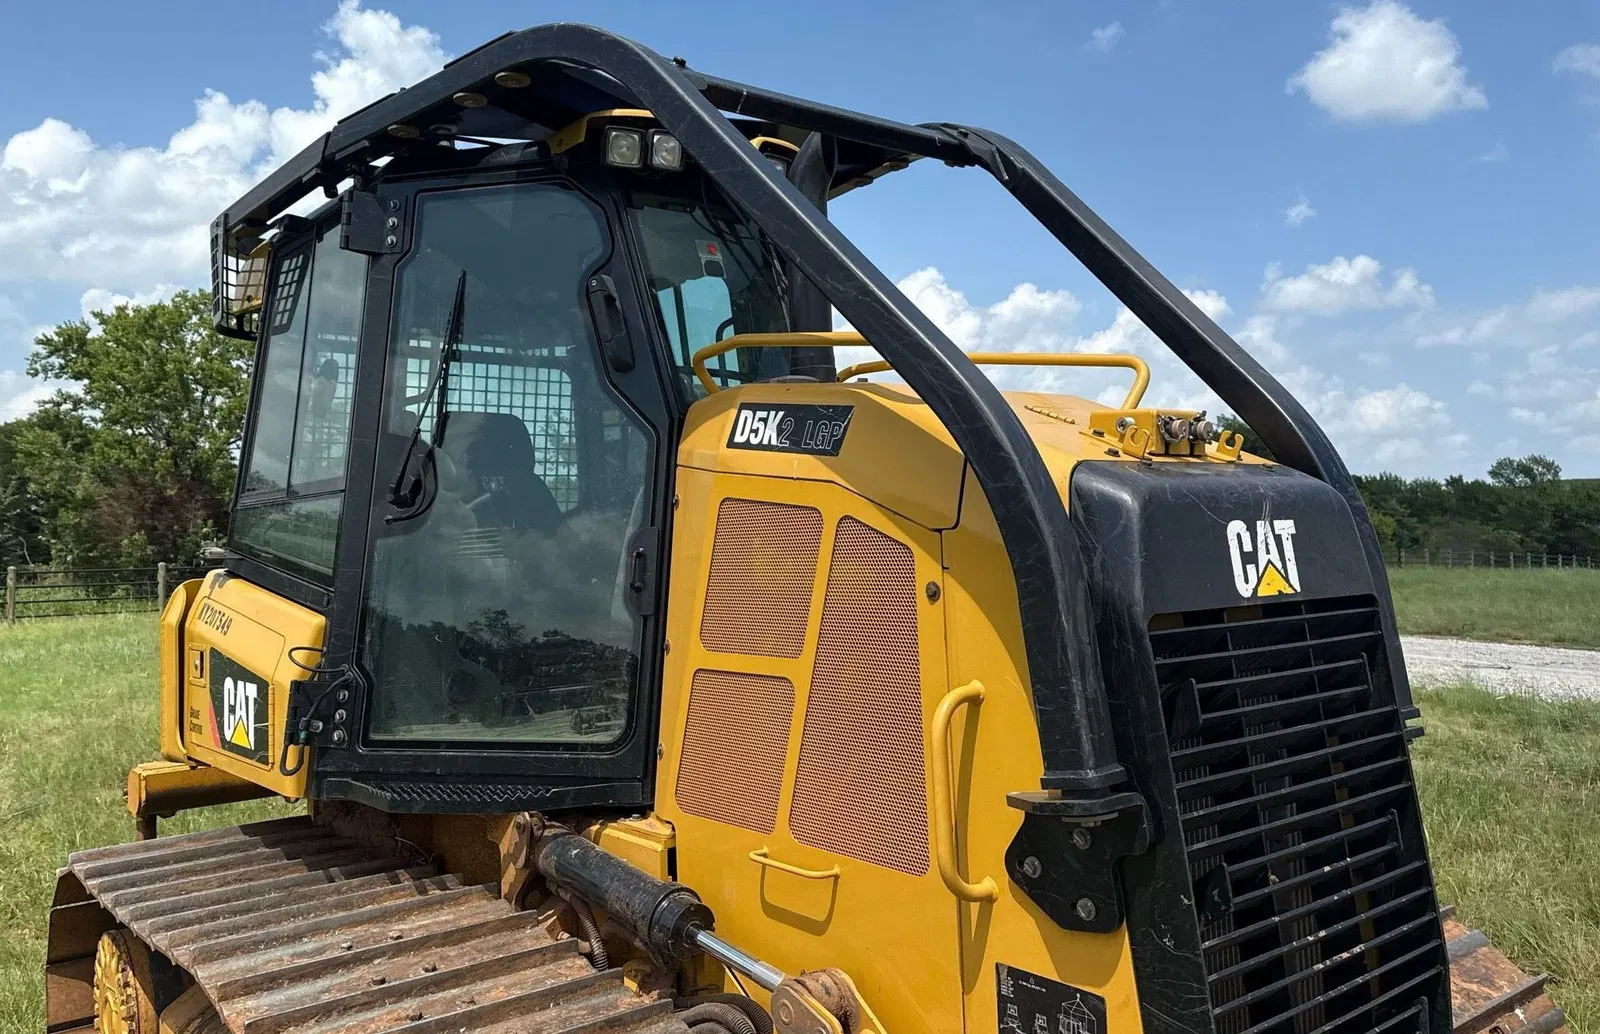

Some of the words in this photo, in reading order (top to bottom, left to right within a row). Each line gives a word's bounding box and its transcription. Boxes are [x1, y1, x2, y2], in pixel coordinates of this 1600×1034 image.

[802, 420, 844, 450] LGP
[1226, 519, 1301, 598] CAT
[223, 676, 257, 751] CAT
